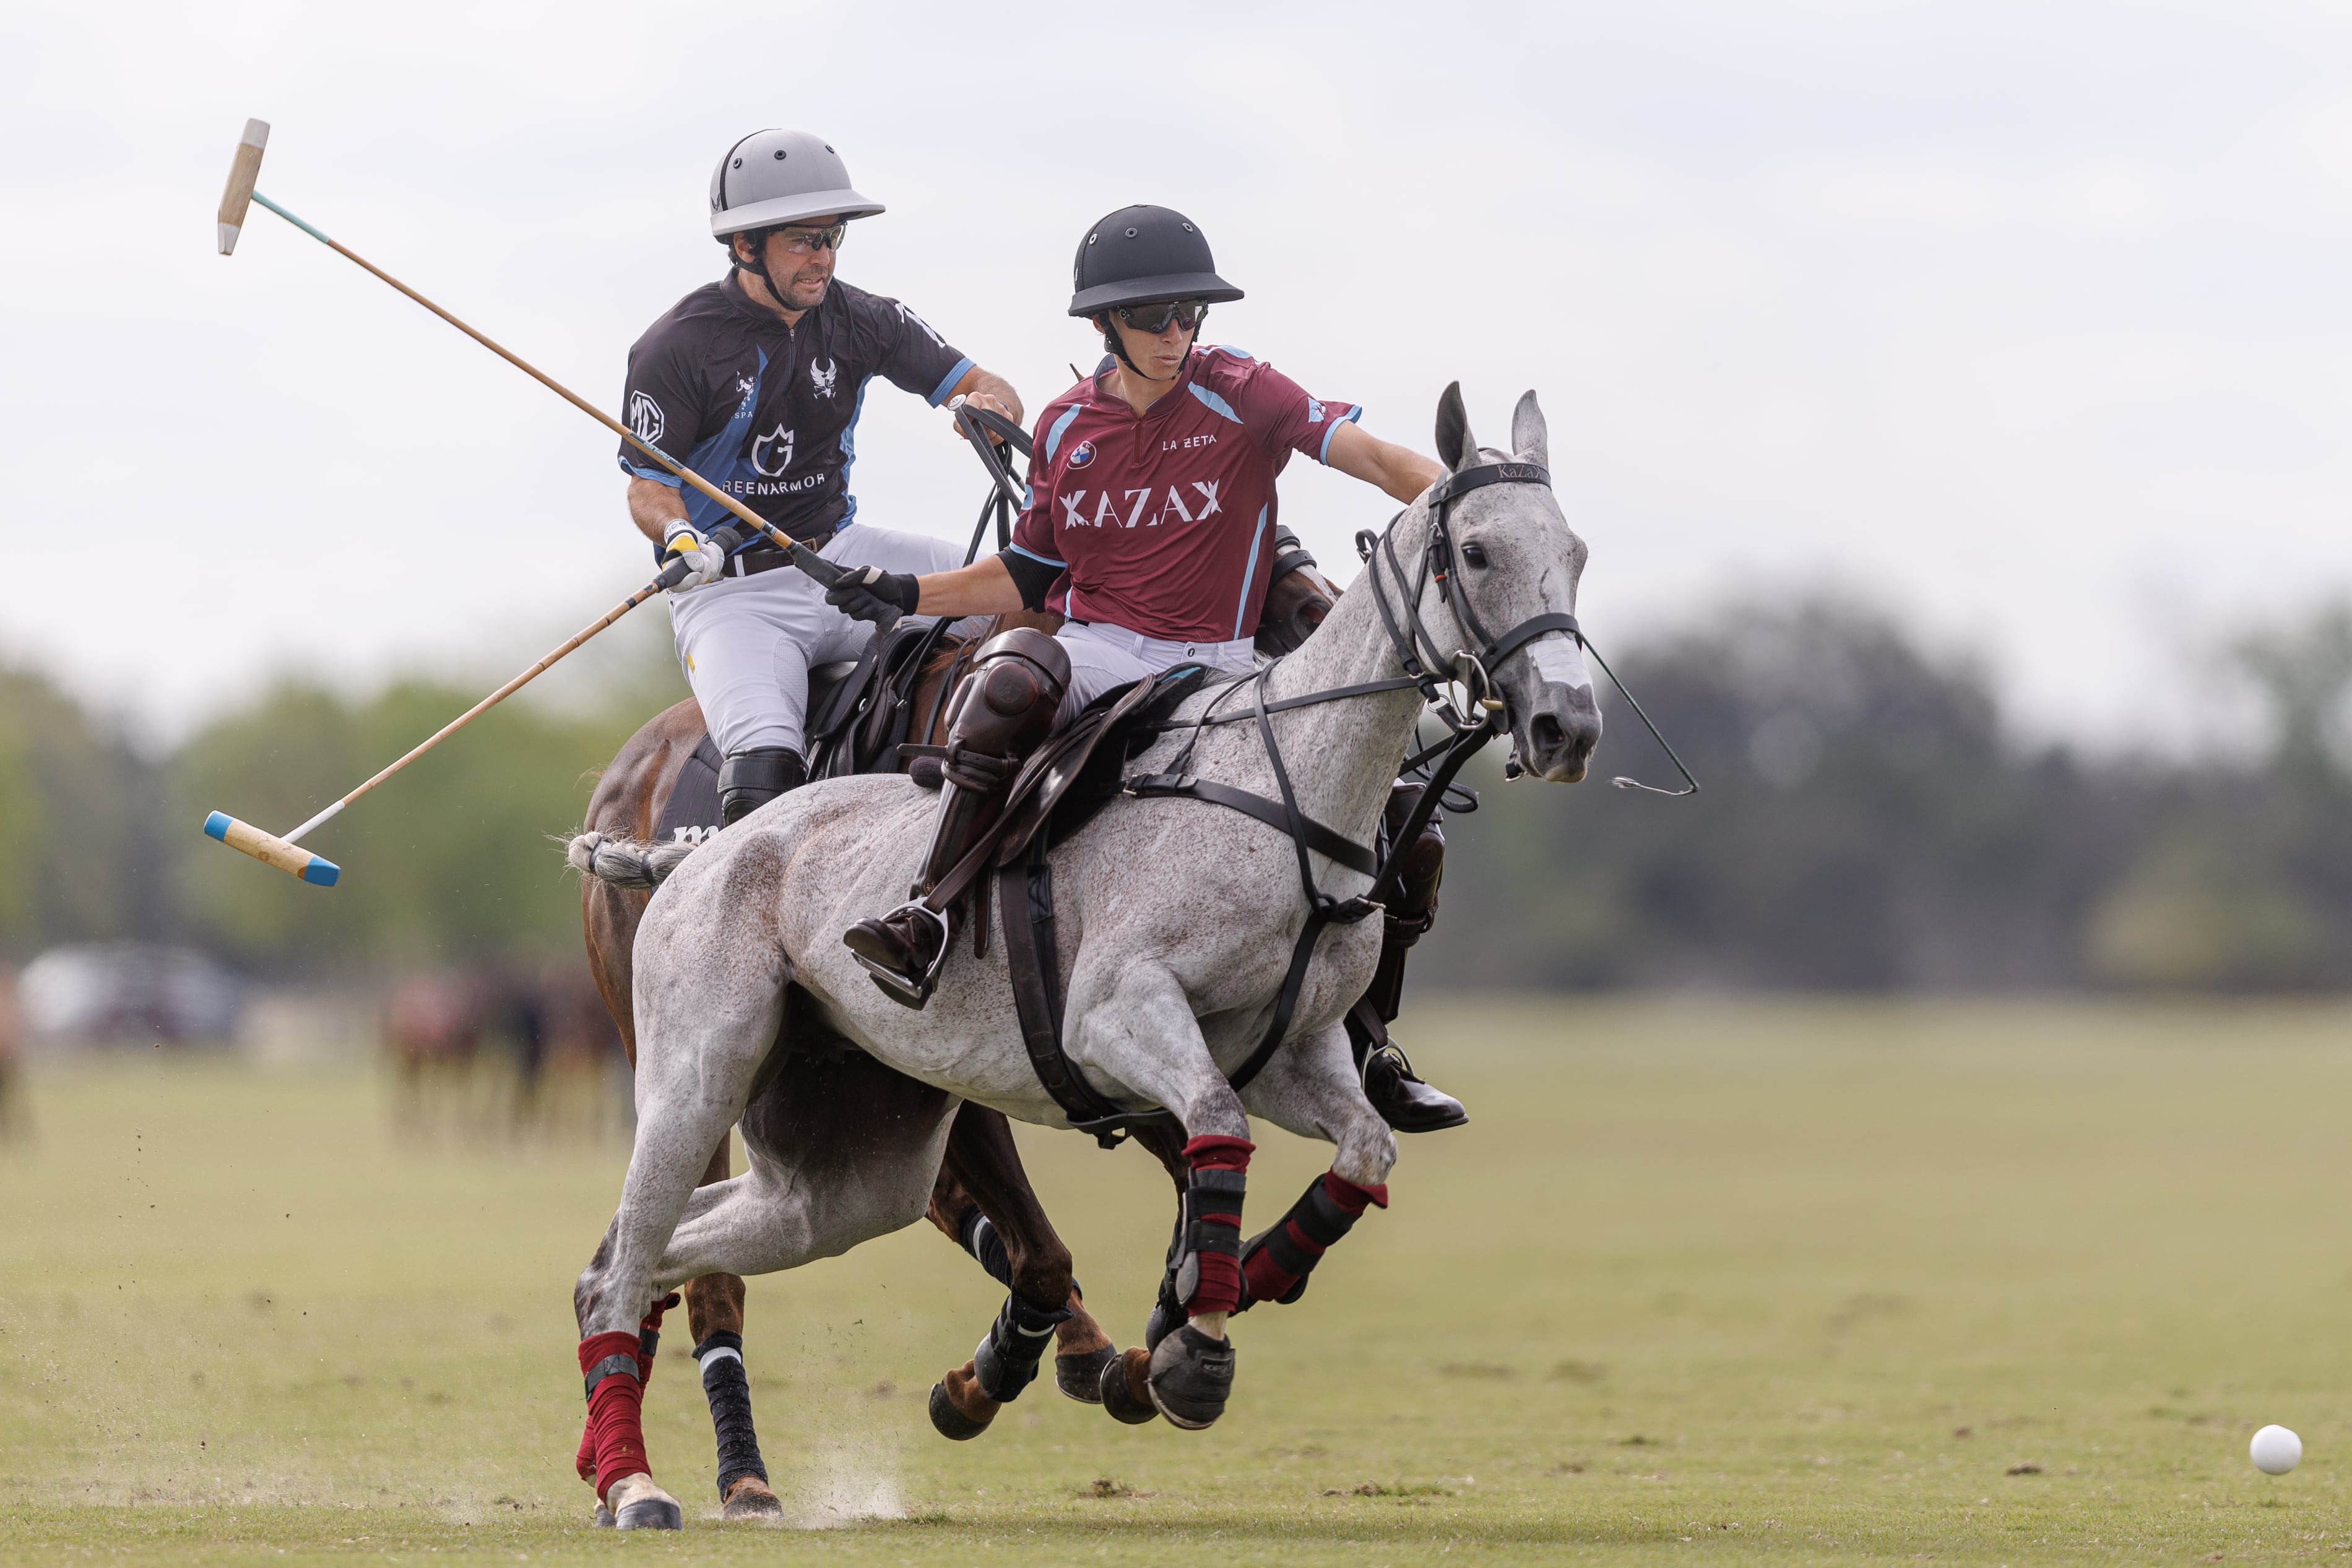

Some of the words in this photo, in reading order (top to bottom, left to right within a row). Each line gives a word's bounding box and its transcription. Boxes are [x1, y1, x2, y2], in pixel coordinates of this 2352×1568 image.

[731, 410, 753, 419] SPA
[1162, 440, 1177, 451] LA
[1183, 434, 1217, 448] ZETA
[722, 473, 826, 495] REENARMOR
